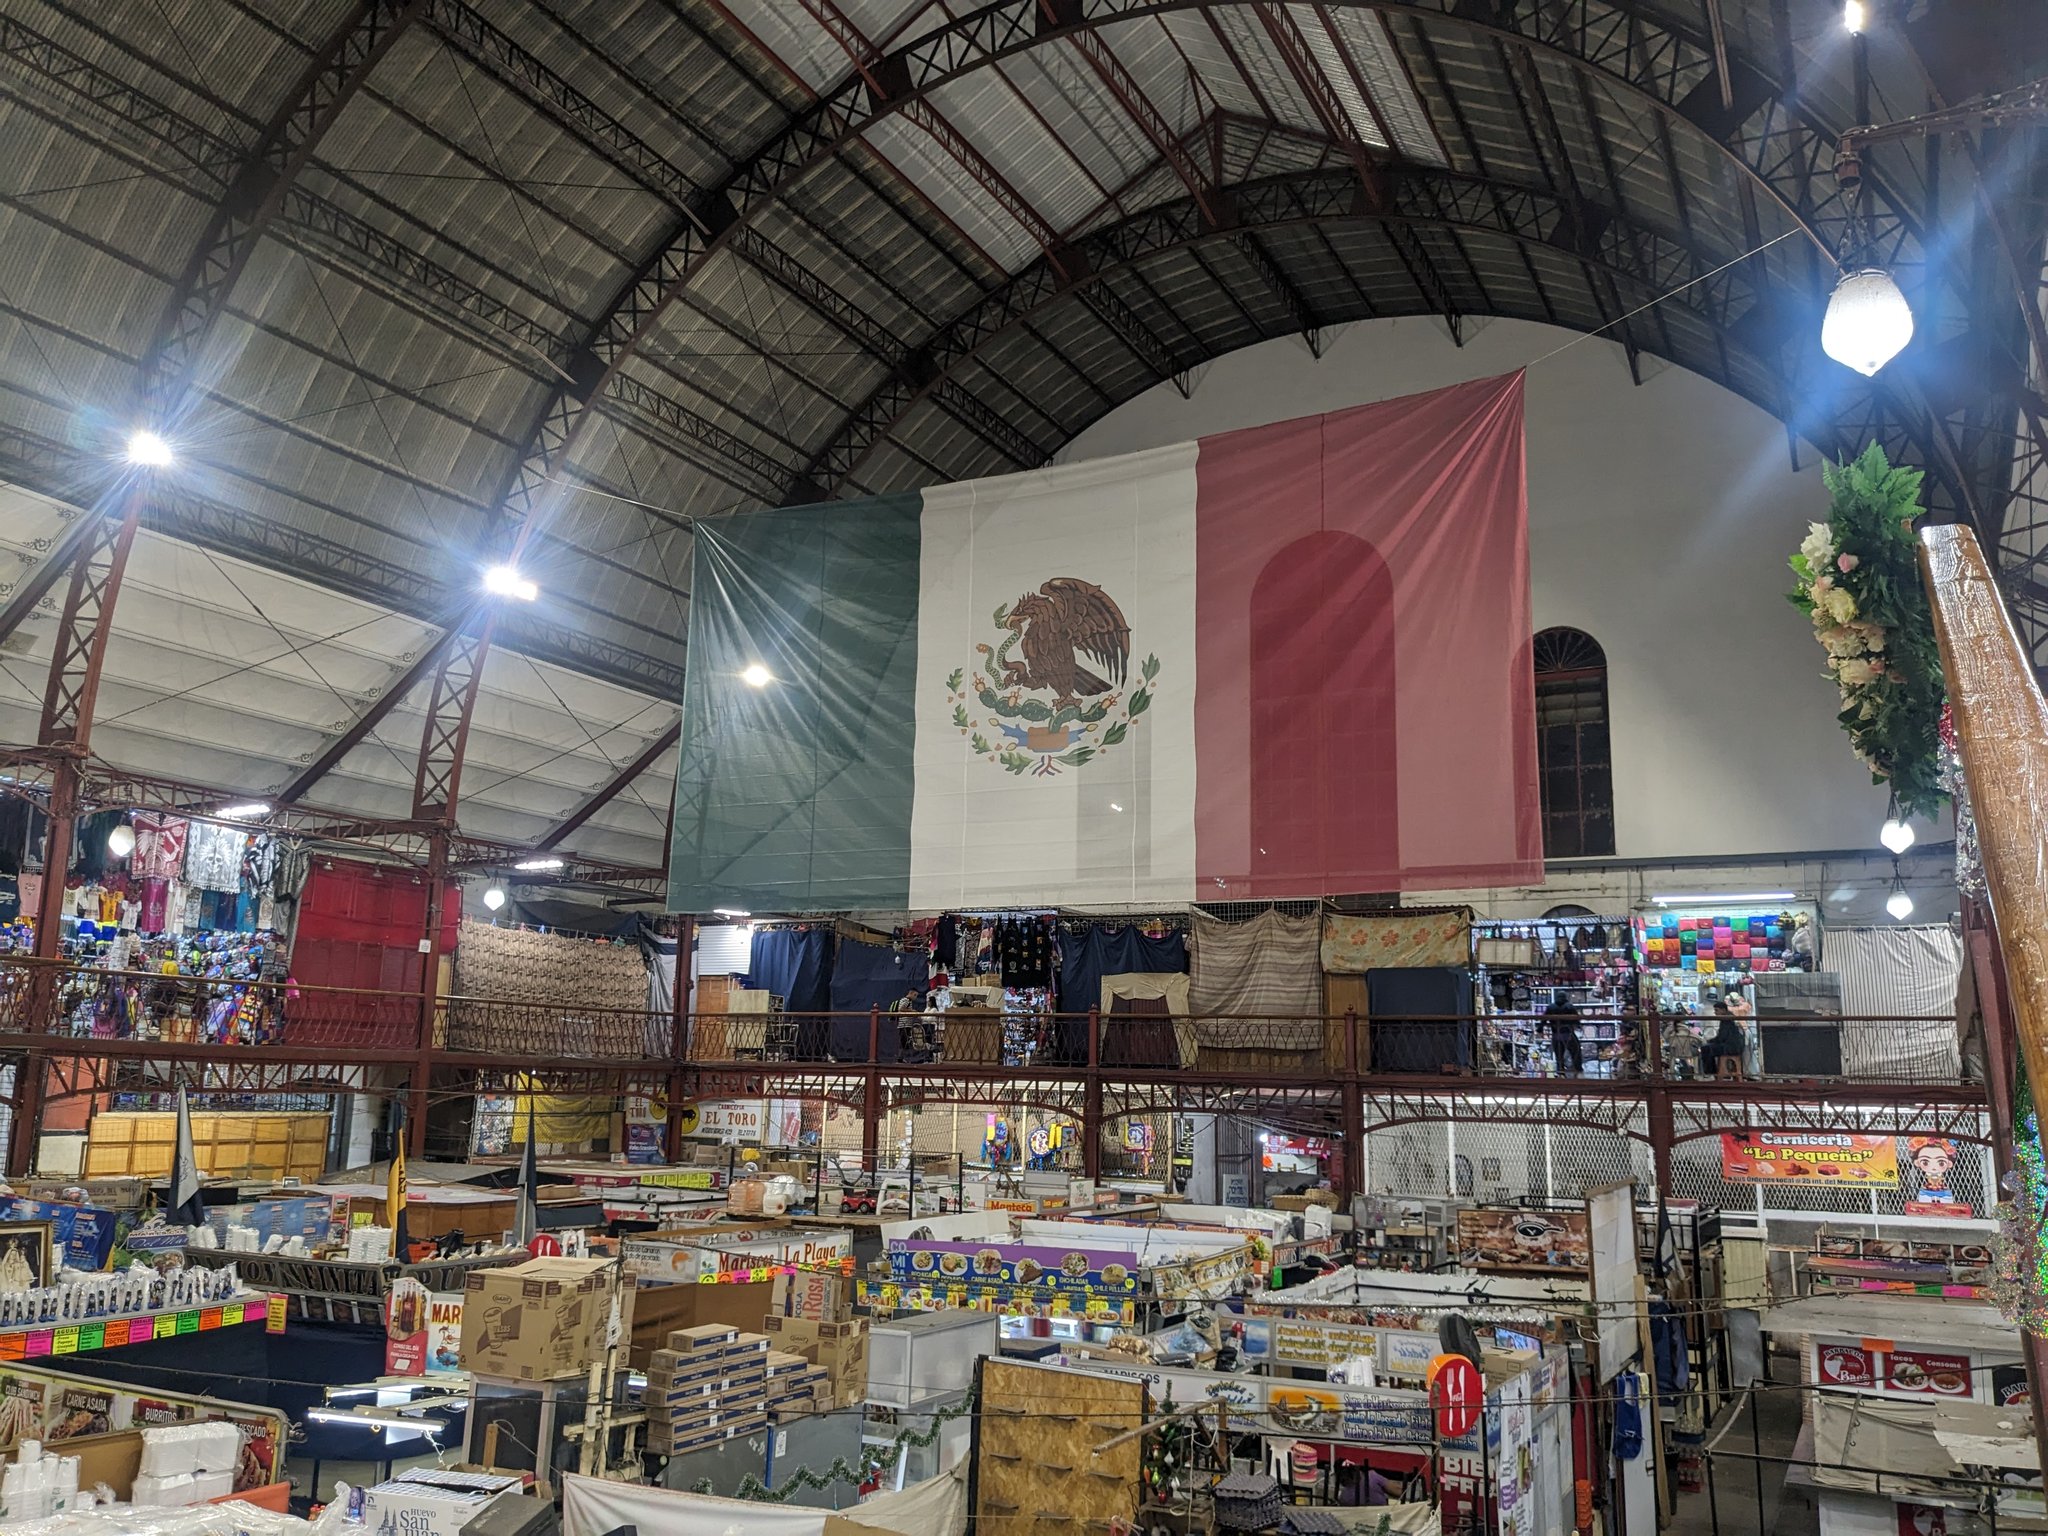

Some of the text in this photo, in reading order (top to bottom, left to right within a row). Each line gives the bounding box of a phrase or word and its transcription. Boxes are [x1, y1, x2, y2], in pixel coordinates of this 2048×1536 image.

[705, 1111, 756, 1126] EL TORO
[990, 1201, 1032, 1213] Manteca
[719, 1243, 837, 1272] Mariscos La Playa
[802, 1278, 824, 1313] ROSA
[1890, 1353, 1914, 1362] Tacos
[17, 1387, 41, 1400] SANDWICH
[66, 1392, 107, 1412] CARNE ASADA
[145, 1407, 177, 1421] BURRITOS
[1376, 1412, 1407, 1428] Pescado
[1342, 1422, 1368, 1439] Vuelve
[1383, 1427, 1402, 1440] Vida
[400, 1509, 430, 1530] San
[410, 1508, 437, 1518] HUEVO
